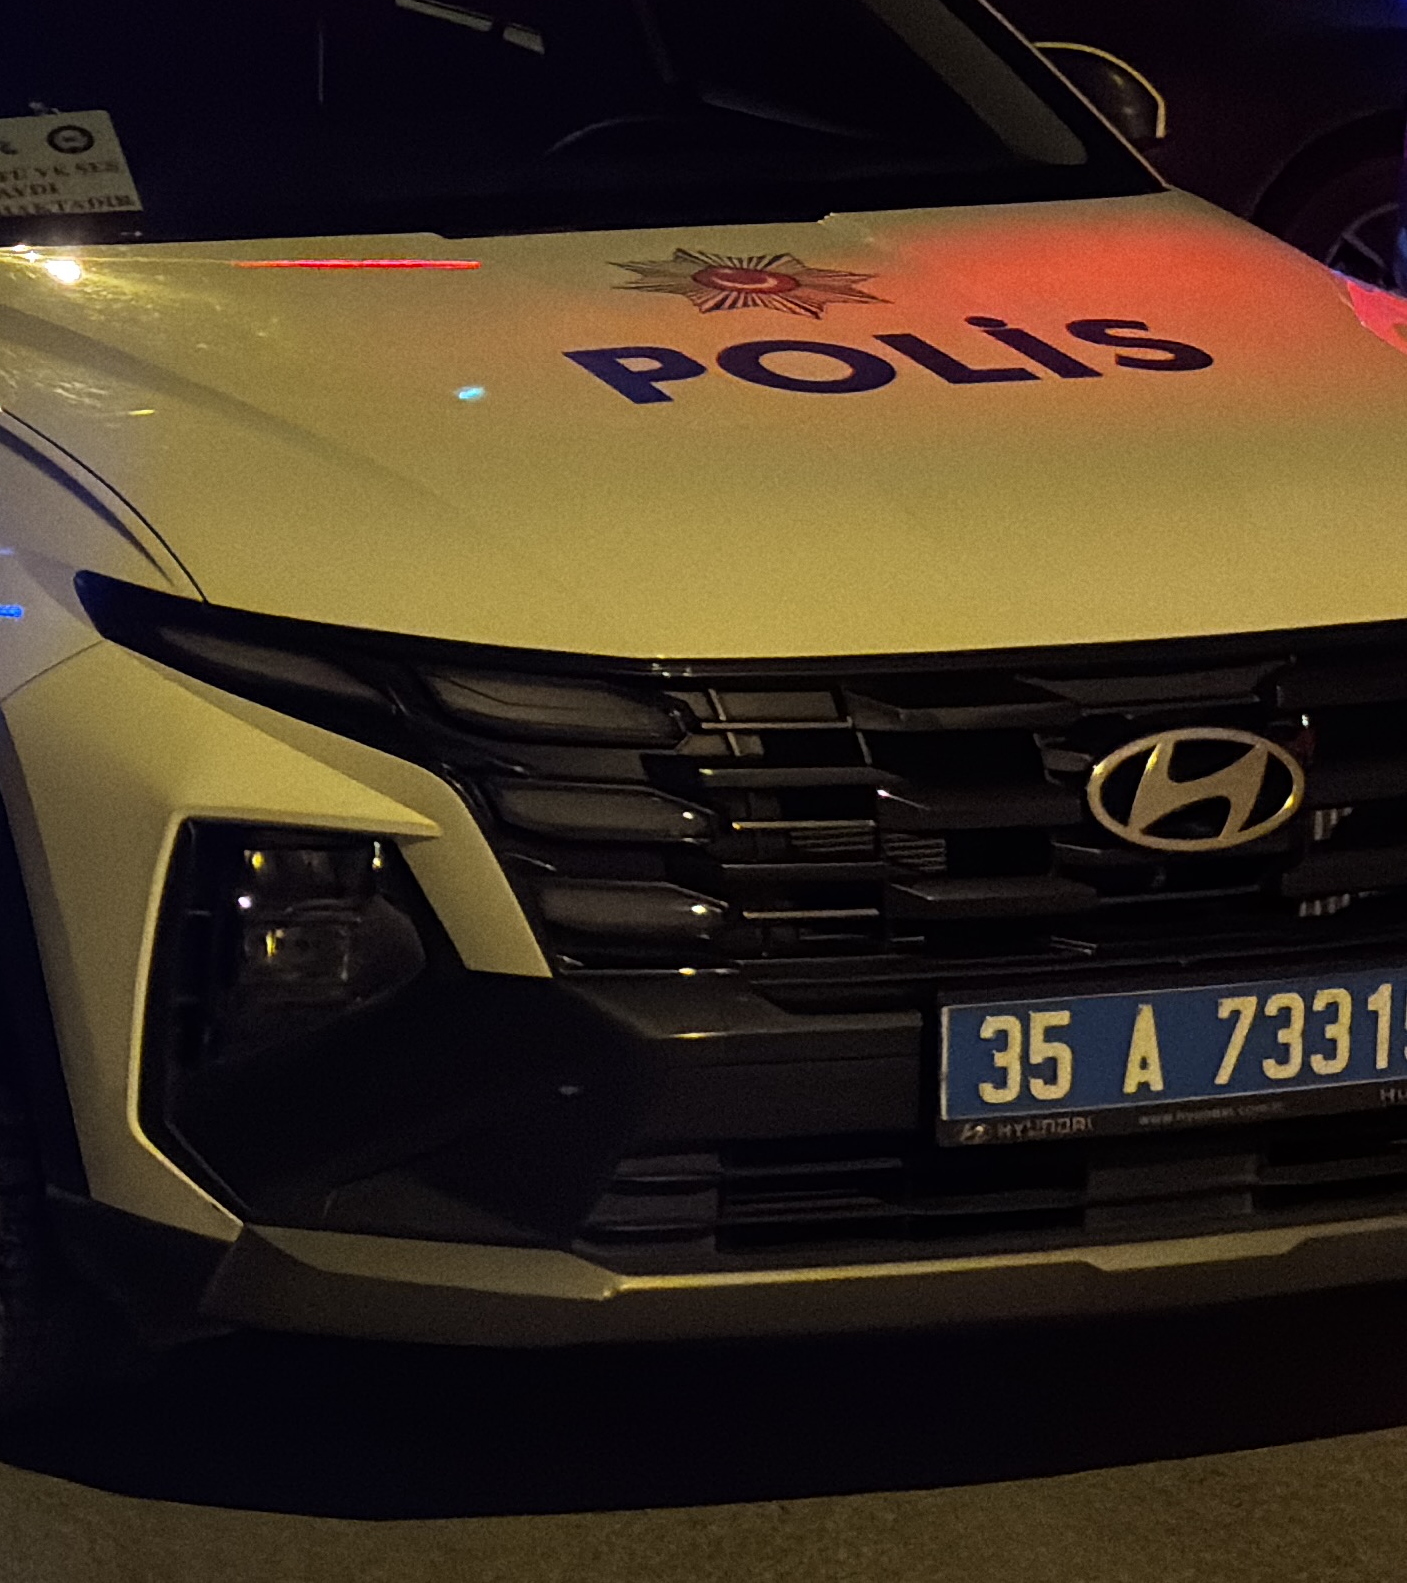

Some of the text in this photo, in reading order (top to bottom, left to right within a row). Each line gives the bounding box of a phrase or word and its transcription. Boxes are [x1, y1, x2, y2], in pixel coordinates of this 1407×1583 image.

[978, 983, 1407, 1105] 35 A 7331
